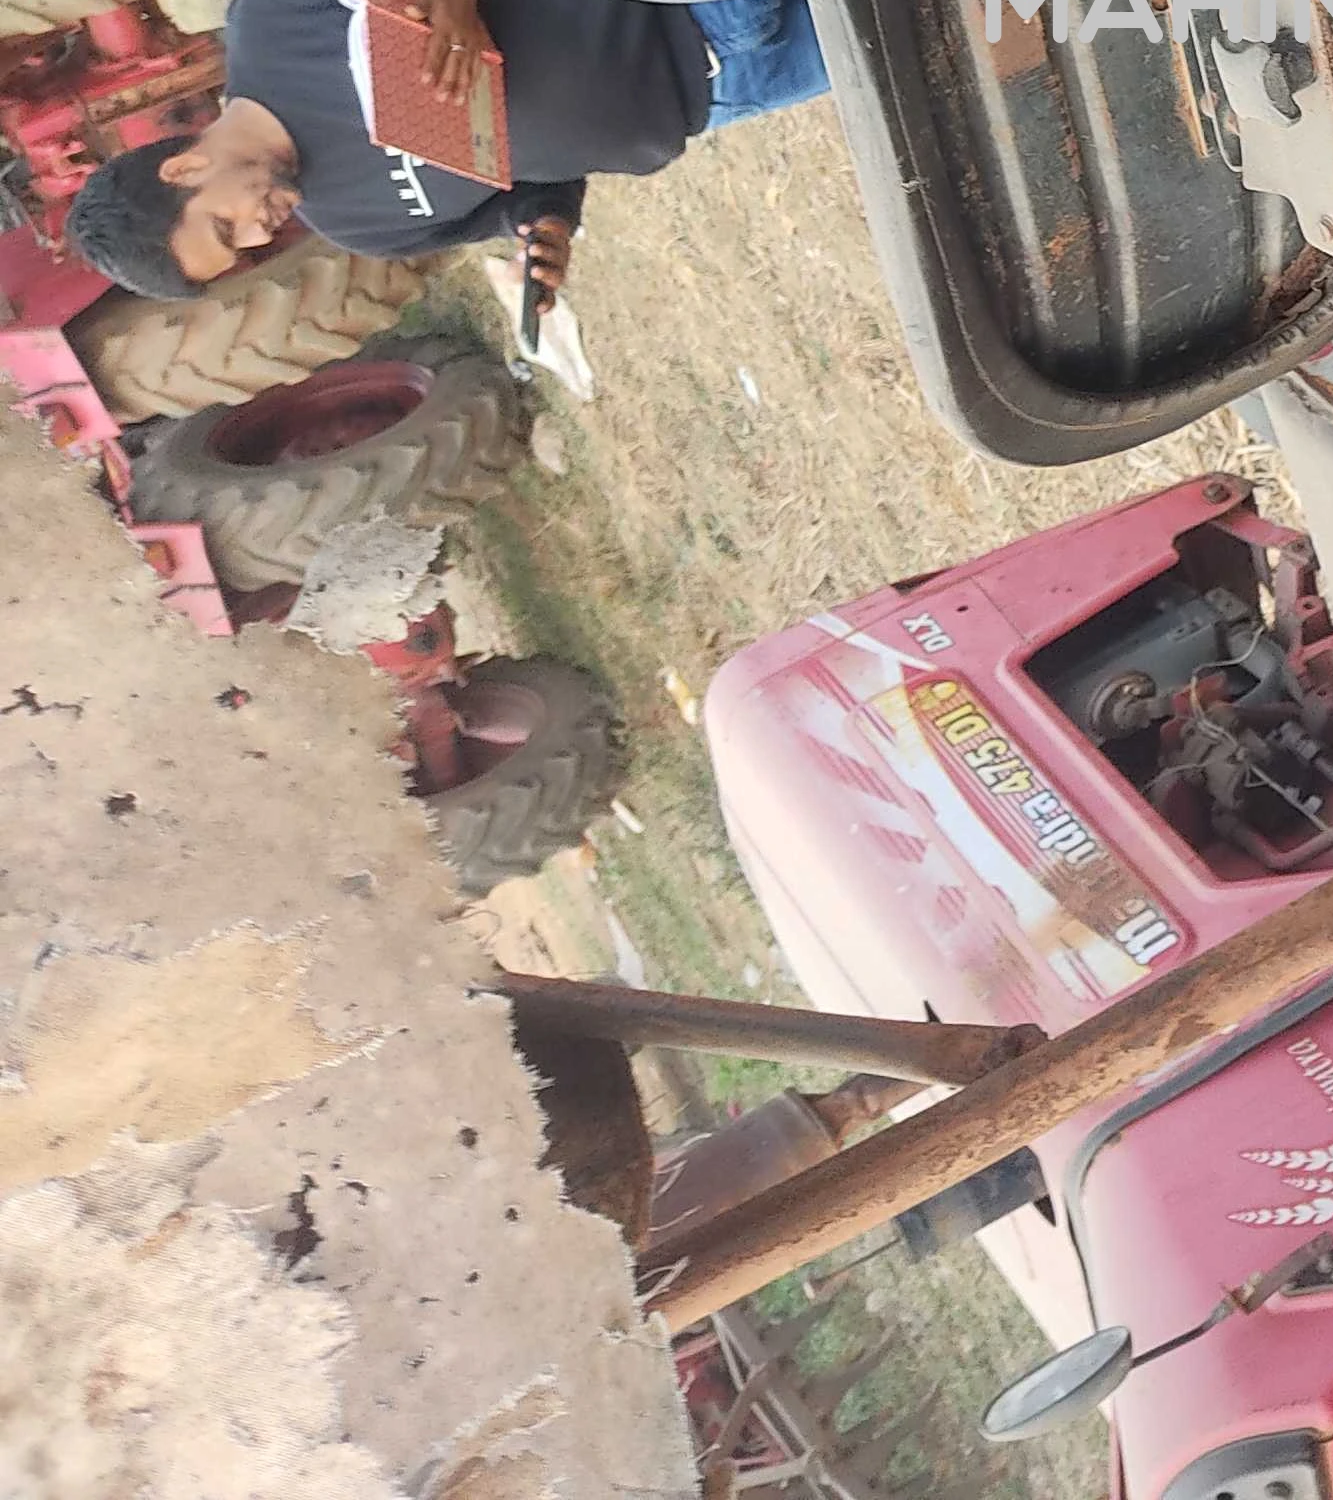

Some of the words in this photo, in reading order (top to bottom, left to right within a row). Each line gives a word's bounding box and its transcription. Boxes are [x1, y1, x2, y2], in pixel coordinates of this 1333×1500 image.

[902, 611, 955, 654] DLX
[932, 703, 993, 748] DI
[964, 737, 1035, 798] 475
